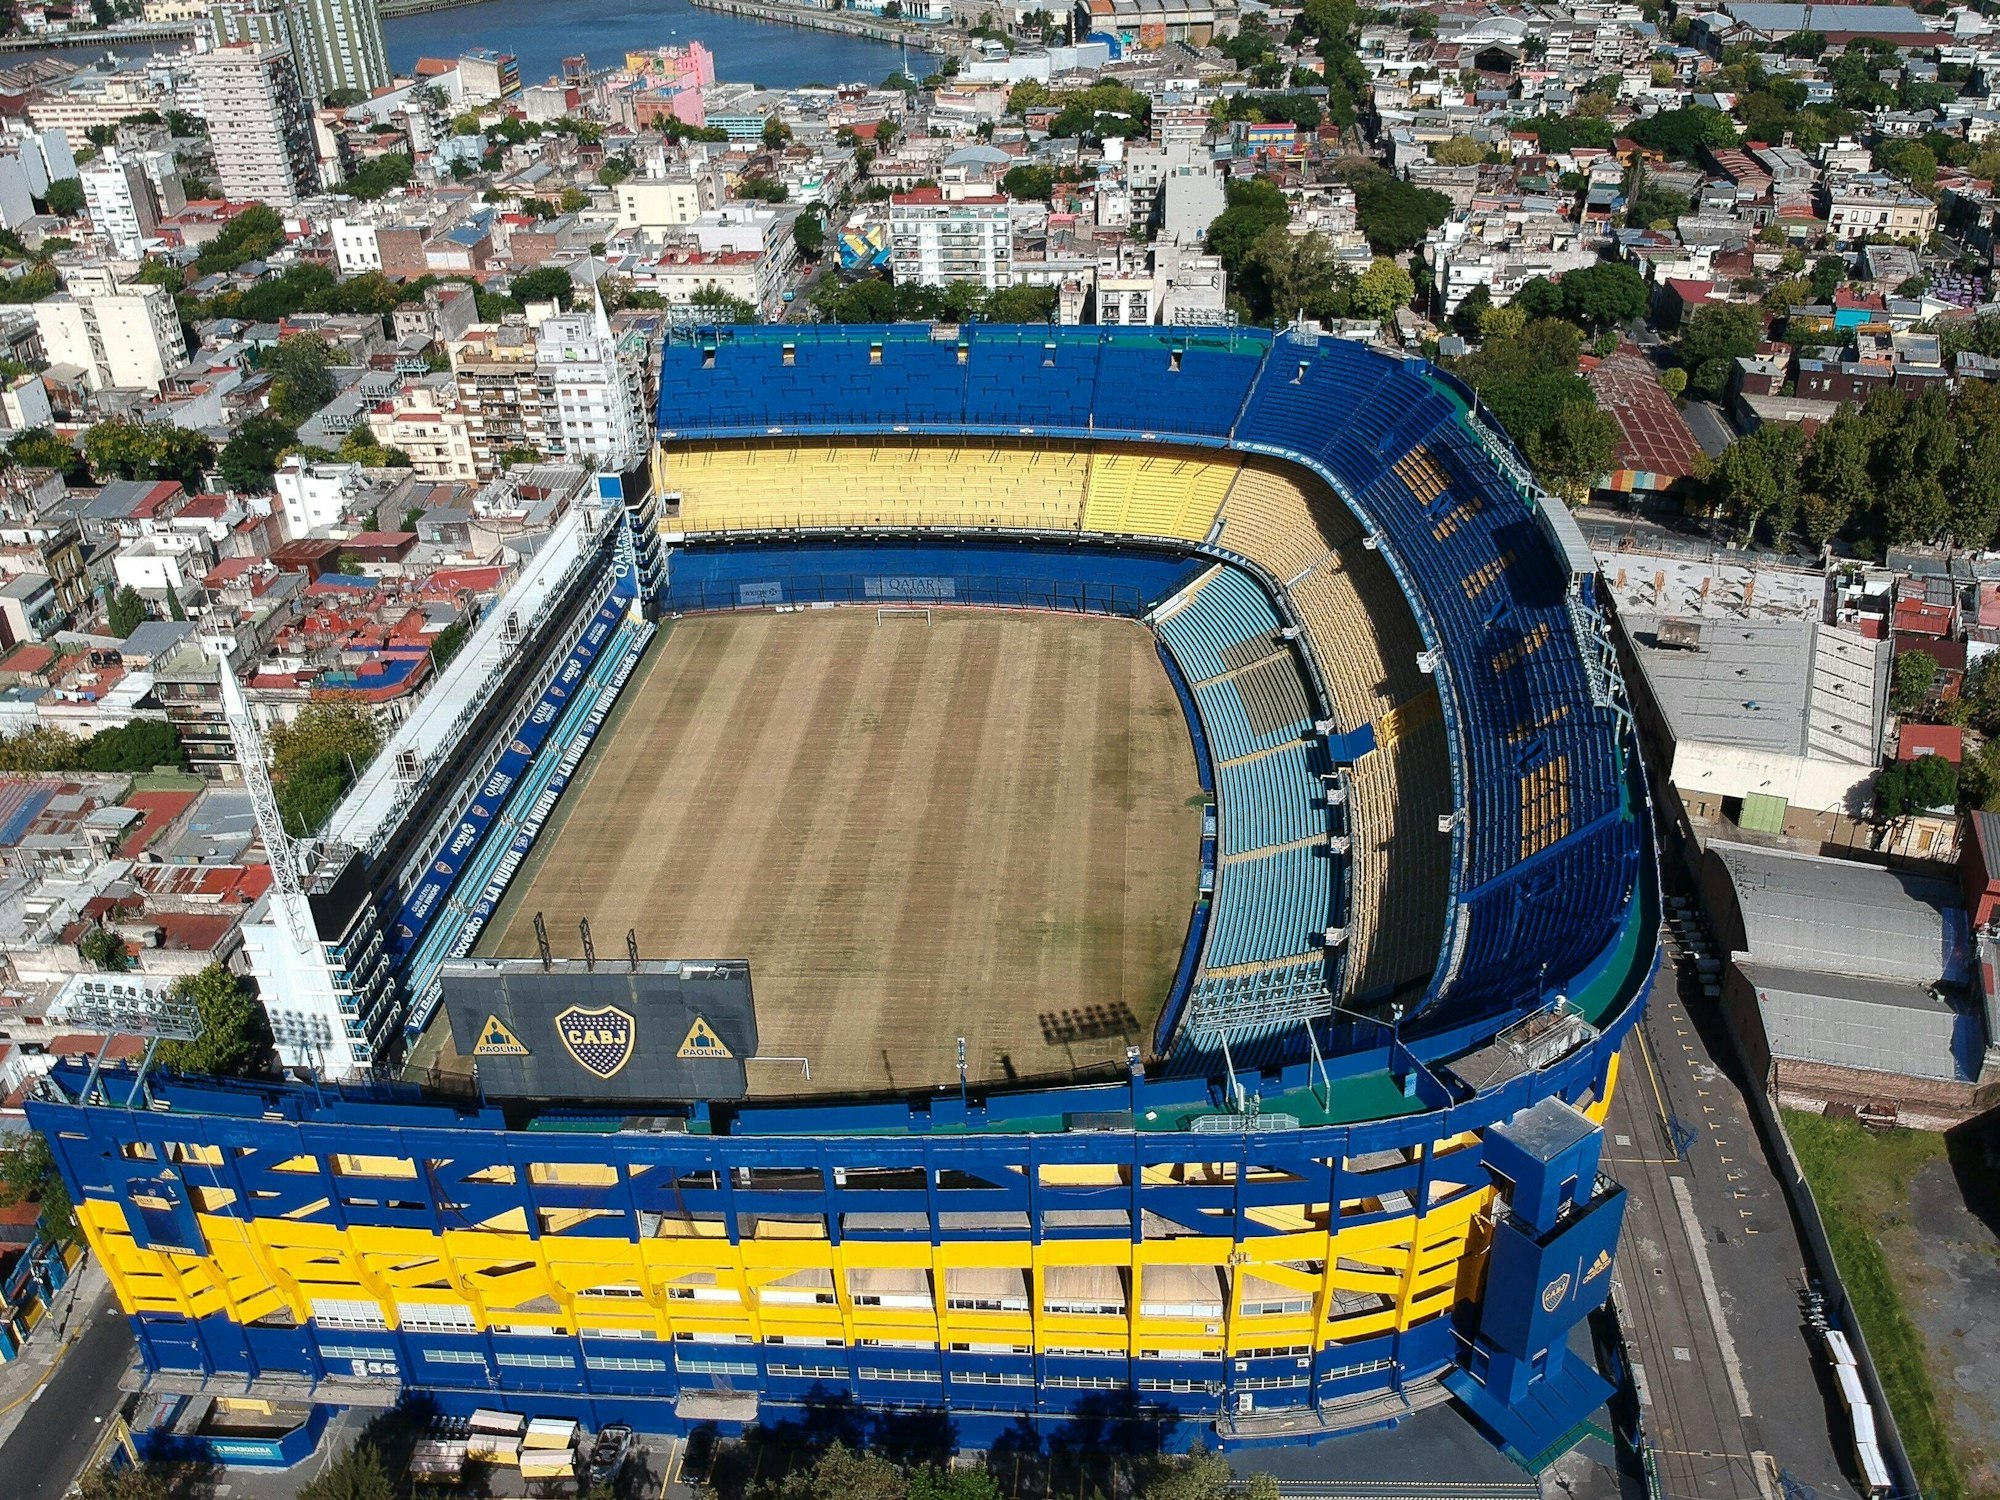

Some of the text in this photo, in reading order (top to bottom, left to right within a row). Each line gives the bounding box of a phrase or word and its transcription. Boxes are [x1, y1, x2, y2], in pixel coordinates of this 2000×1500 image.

[889, 578, 935, 591] QATAR
[532, 700, 553, 724] QATAR
[589, 685, 619, 725] LA NUEVA
[558, 734, 590, 777] LA NUEVA
[484, 771, 507, 797] QATAR
[522, 788, 558, 837] LA NUEVA
[450, 828, 469, 855] AXION
[483, 850, 523, 902] LA NUEVA
[416, 884, 441, 918] BOCA JUNIORS
[568, 1030, 627, 1044] CABJ
[1582, 1257, 1612, 1284] adidas
